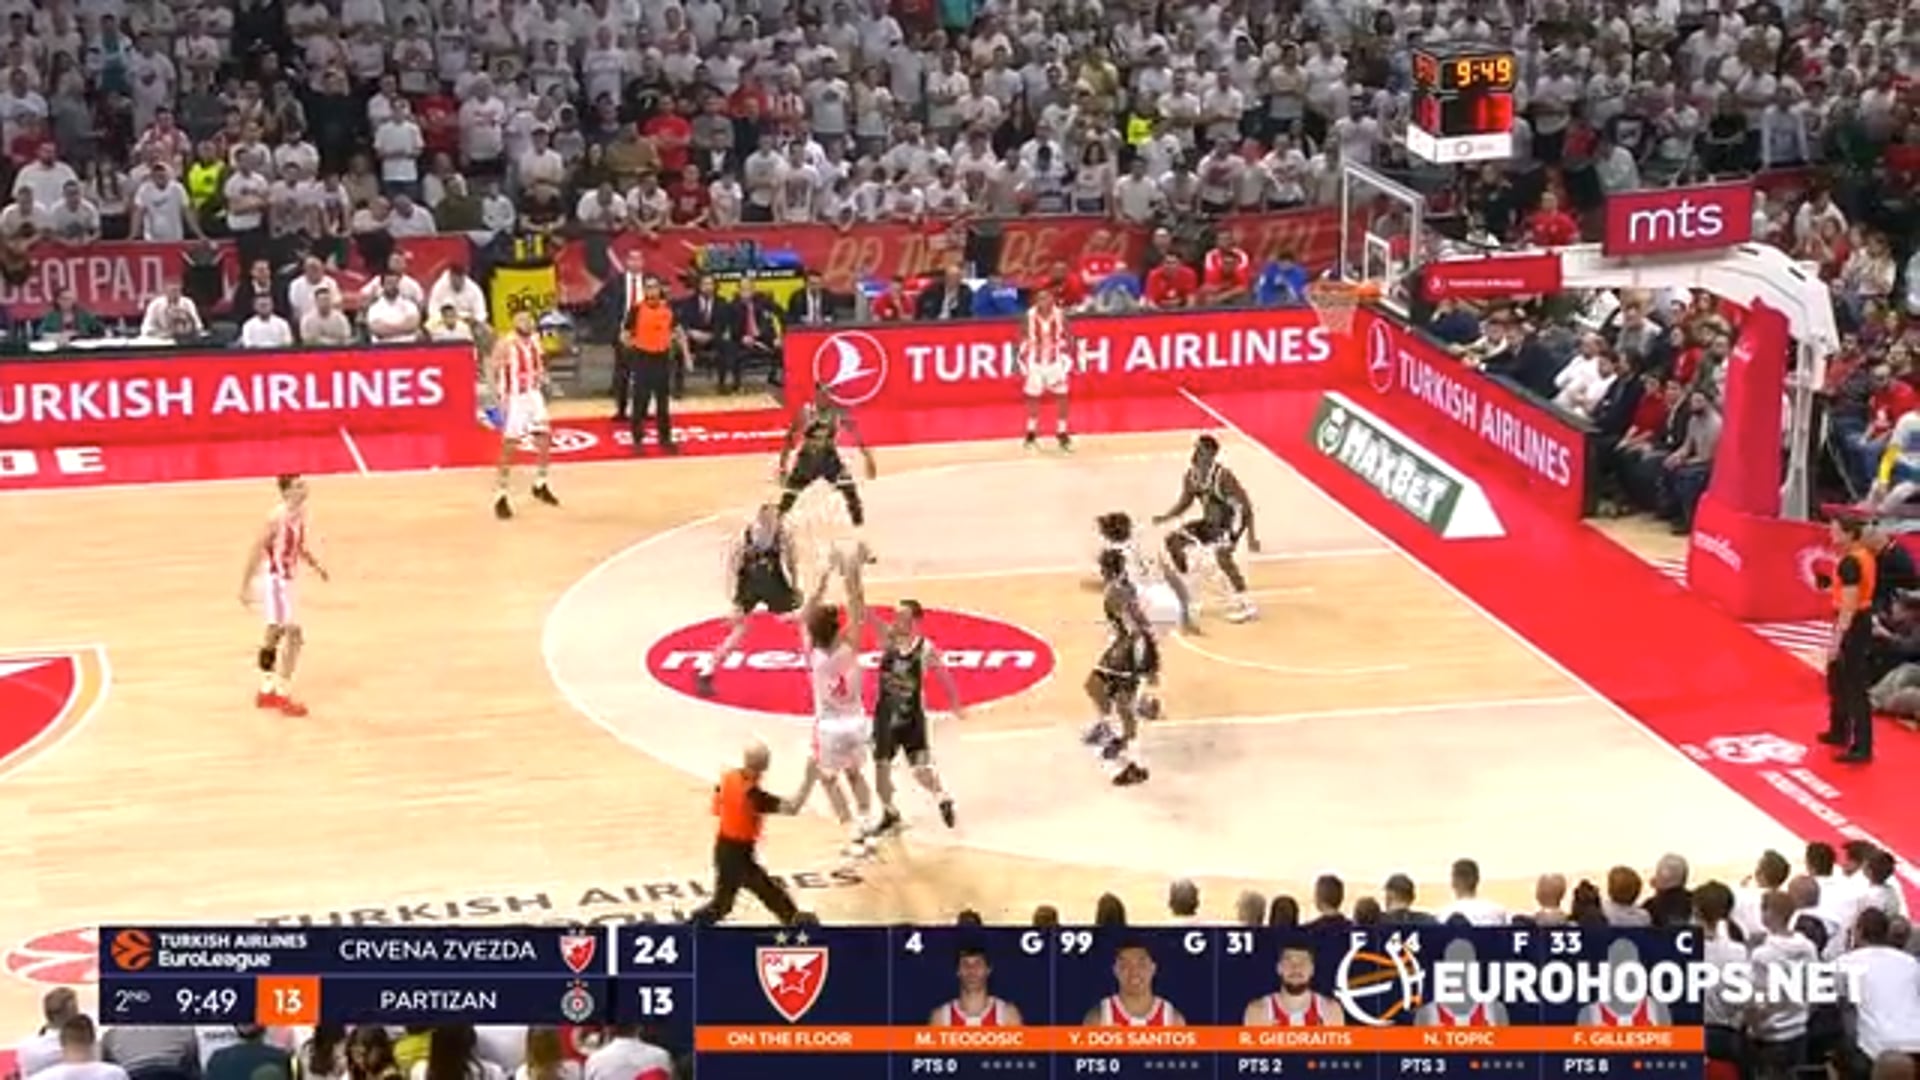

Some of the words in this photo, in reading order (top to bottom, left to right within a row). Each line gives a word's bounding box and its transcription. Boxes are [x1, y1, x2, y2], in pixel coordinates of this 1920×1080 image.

[1457, 57, 1513, 87] 9:49
[1629, 199, 1724, 242] mts
[906, 337, 1108, 383] TURH
[1124, 326, 1332, 372] AIRLINES
[212, 367, 444, 414] AIRLINES
[1398, 350, 1478, 432] TURKISH
[1480, 404, 1572, 487] AIRLINES
[1338, 418, 1446, 524] MAXBET
[660, 648, 1037, 672] mean
[577, 867, 864, 907] AIRLES
